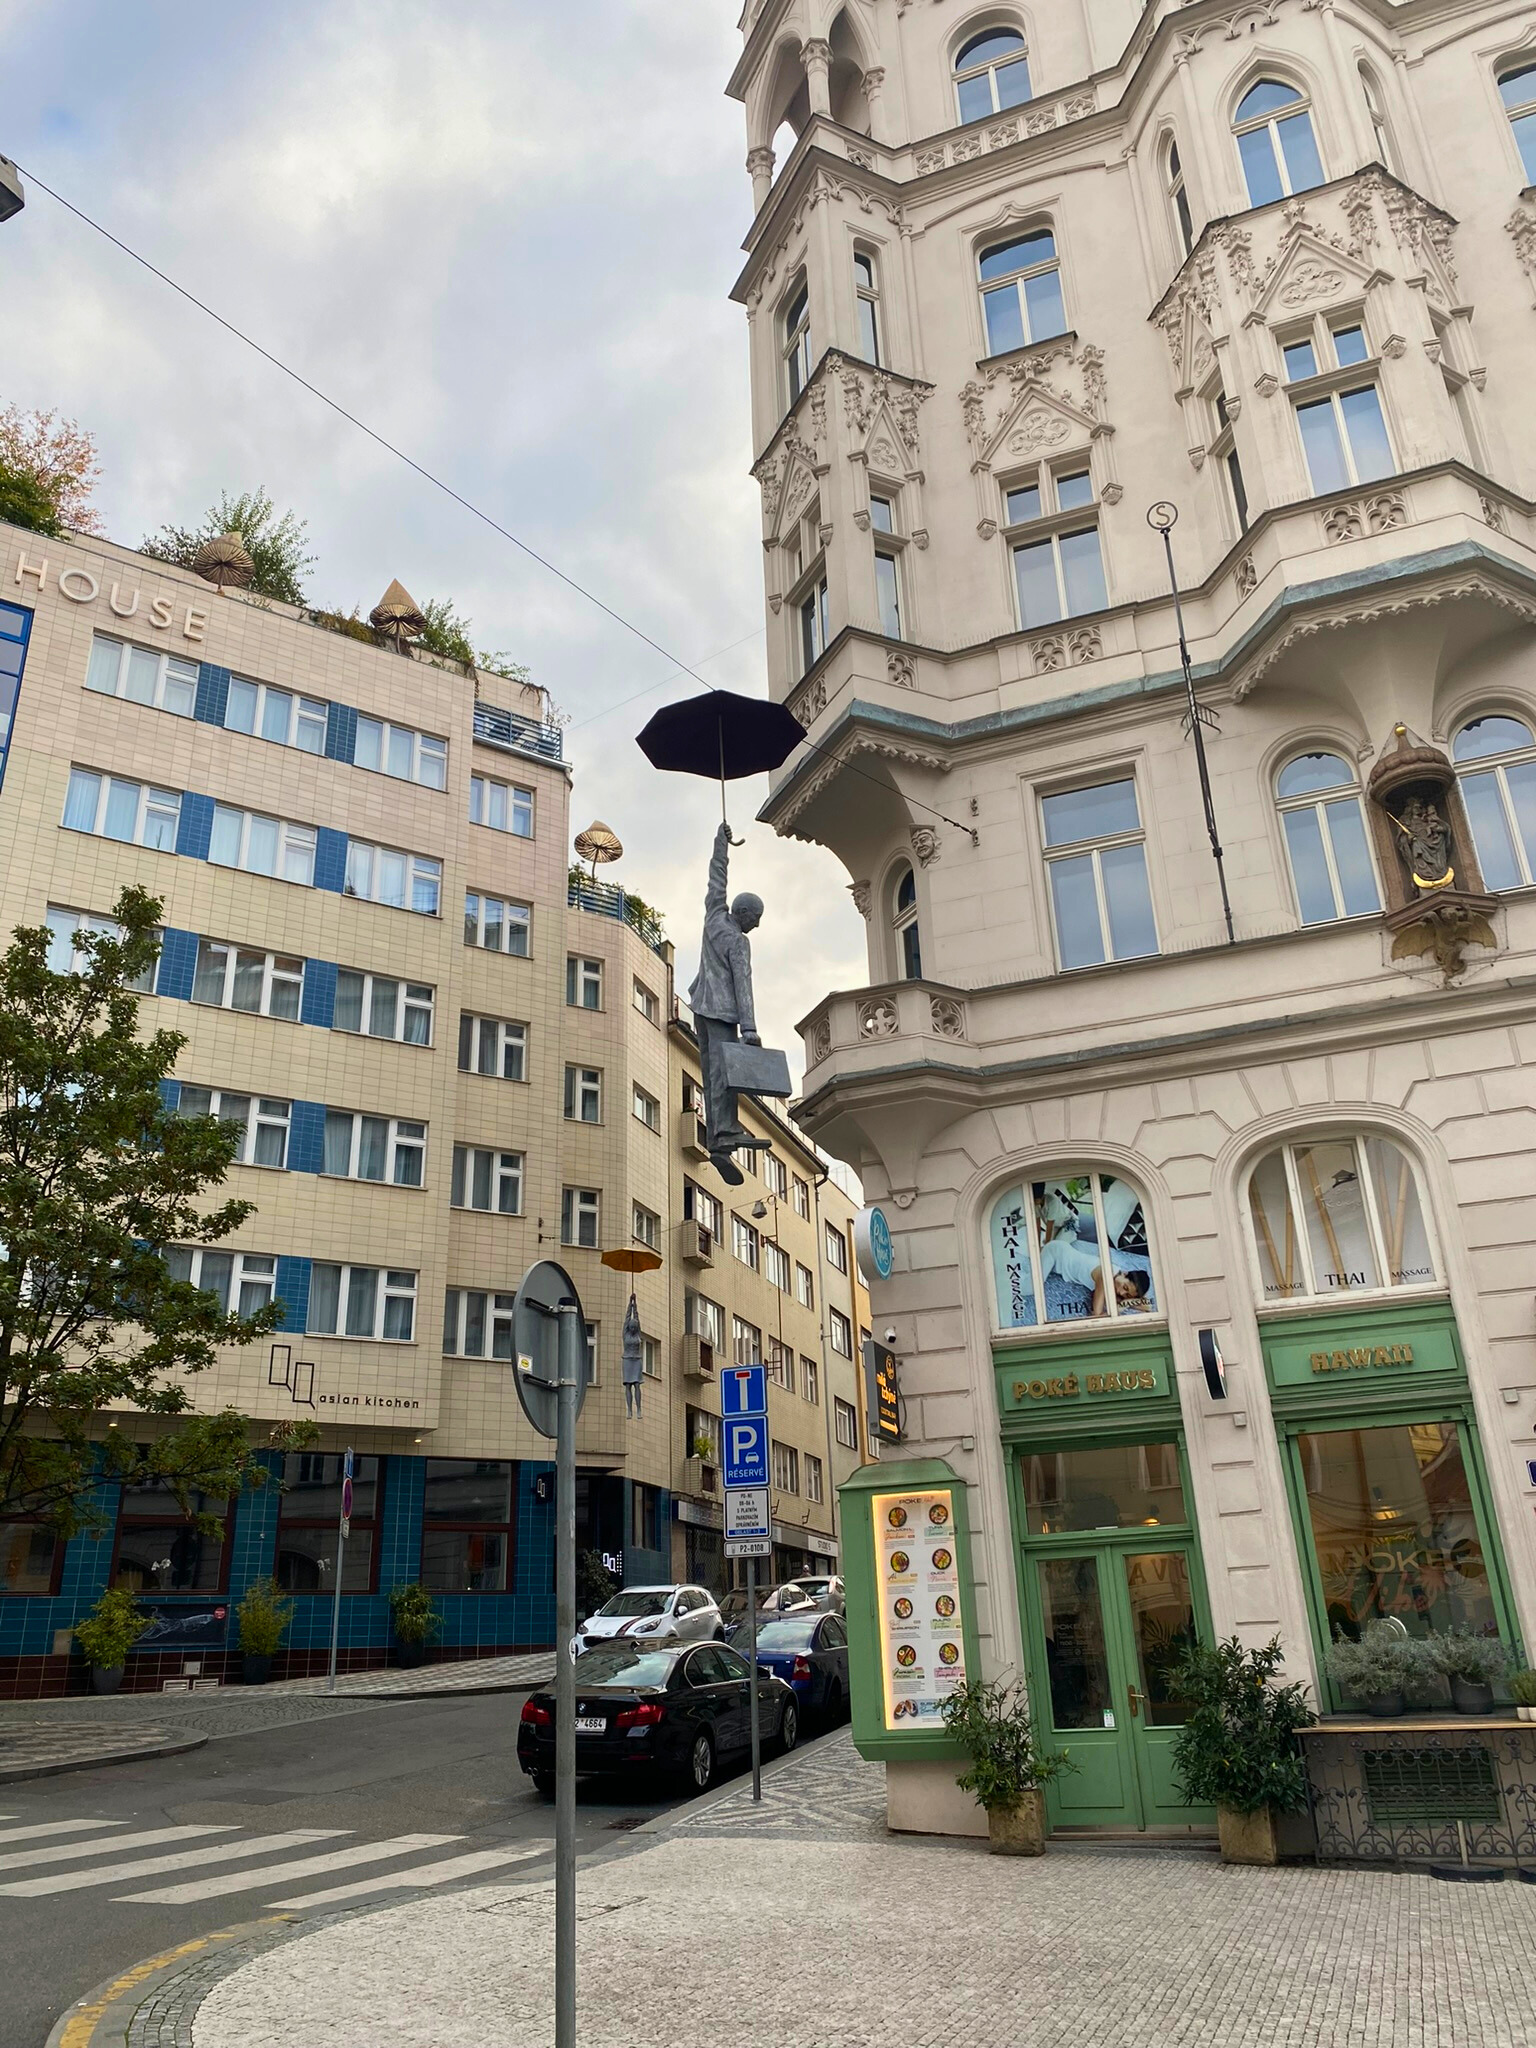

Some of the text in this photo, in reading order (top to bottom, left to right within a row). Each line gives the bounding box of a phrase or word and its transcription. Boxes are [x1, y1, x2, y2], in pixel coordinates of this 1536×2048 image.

[14, 551, 207, 641] HOUSE
[1001, 1216, 1024, 1319] THAI MASSAGE
[1265, 1267, 1432, 1292] MASSAGE THAI MASSAGE
[1057, 1301, 1094, 1315] THA
[1310, 1344, 1414, 1373] HAWAII
[1012, 1369, 1157, 1400] POKÉ HAUS
[319, 1394, 419, 1409] asian kitchen
[728, 1467, 764, 1479] RÉSERVÉ
